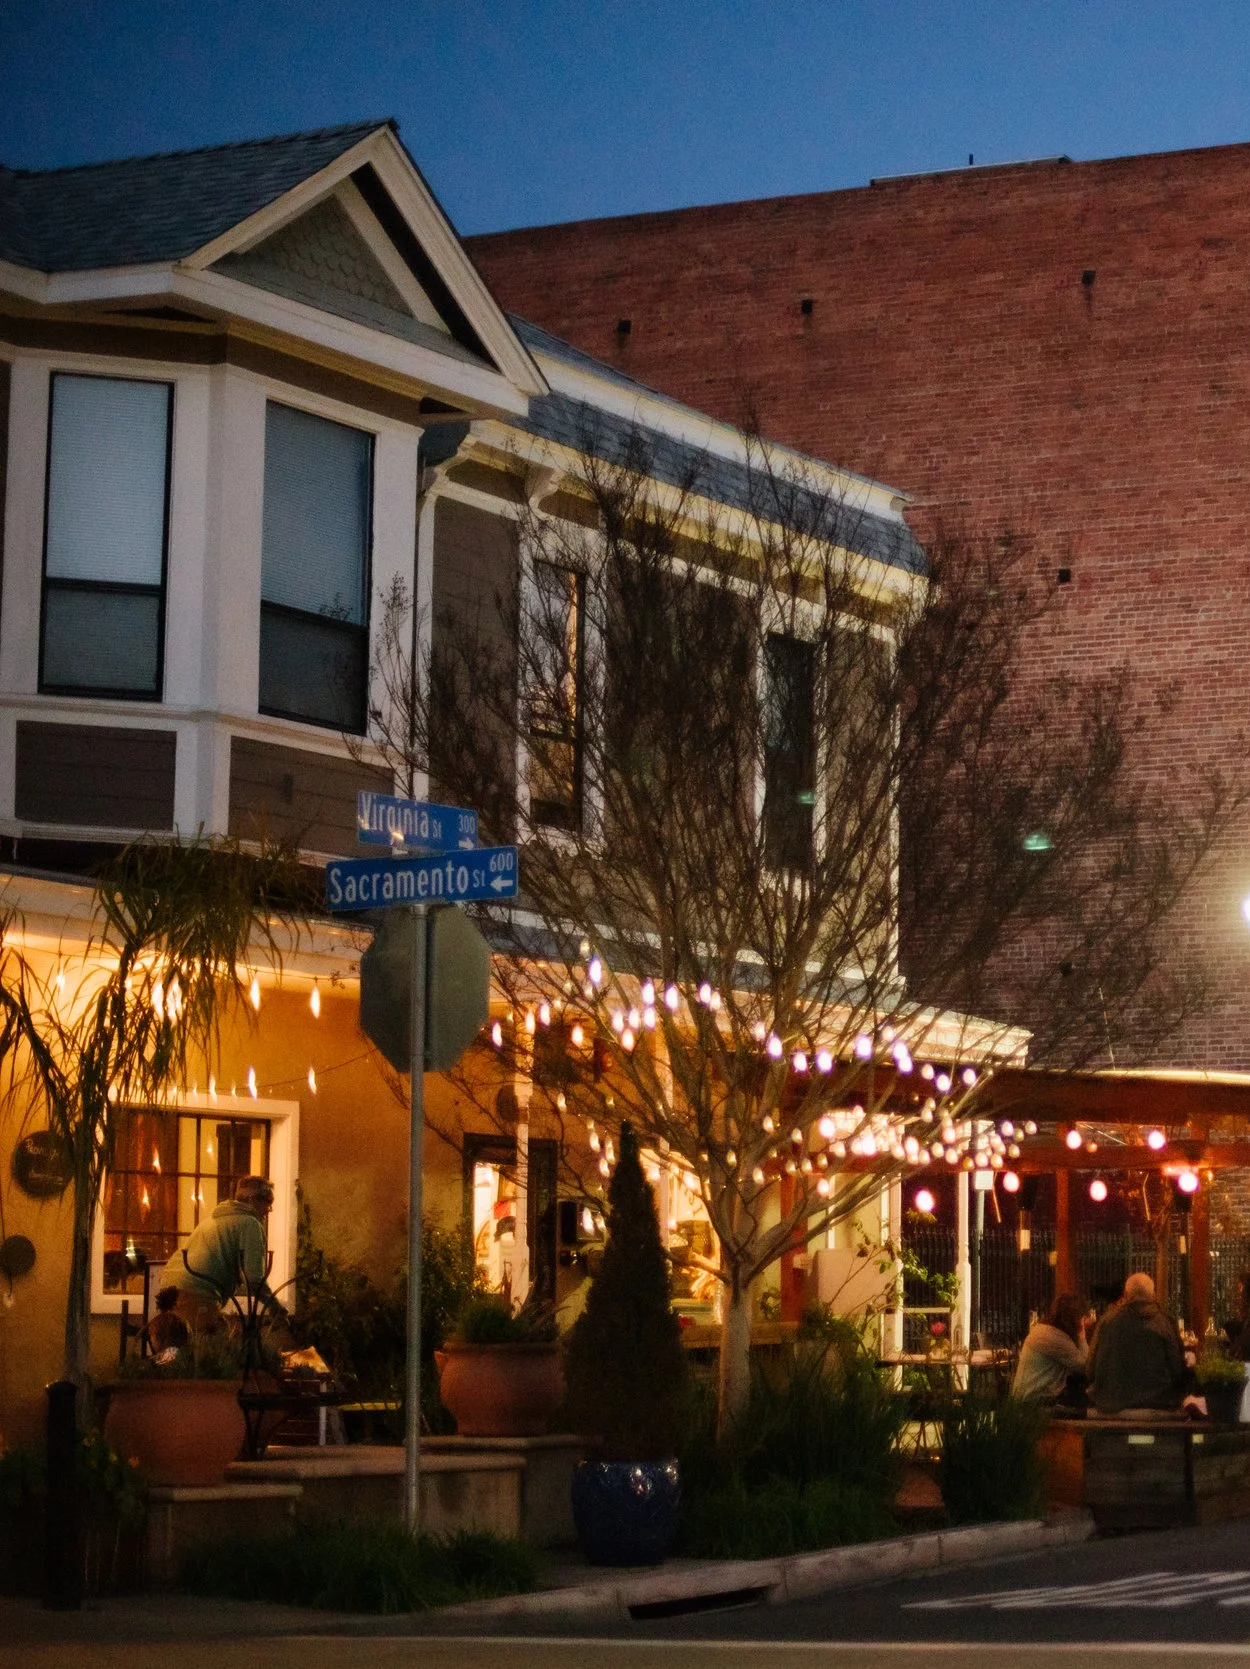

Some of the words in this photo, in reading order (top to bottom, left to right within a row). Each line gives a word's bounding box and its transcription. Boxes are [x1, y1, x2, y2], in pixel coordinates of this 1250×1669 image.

[361, 793, 430, 841] Virginia
[432, 819, 443, 840] St
[458, 814, 476, 835] 300
[489, 852, 514, 873] 600
[330, 861, 469, 904] Sacramento
[472, 869, 486, 889] St
